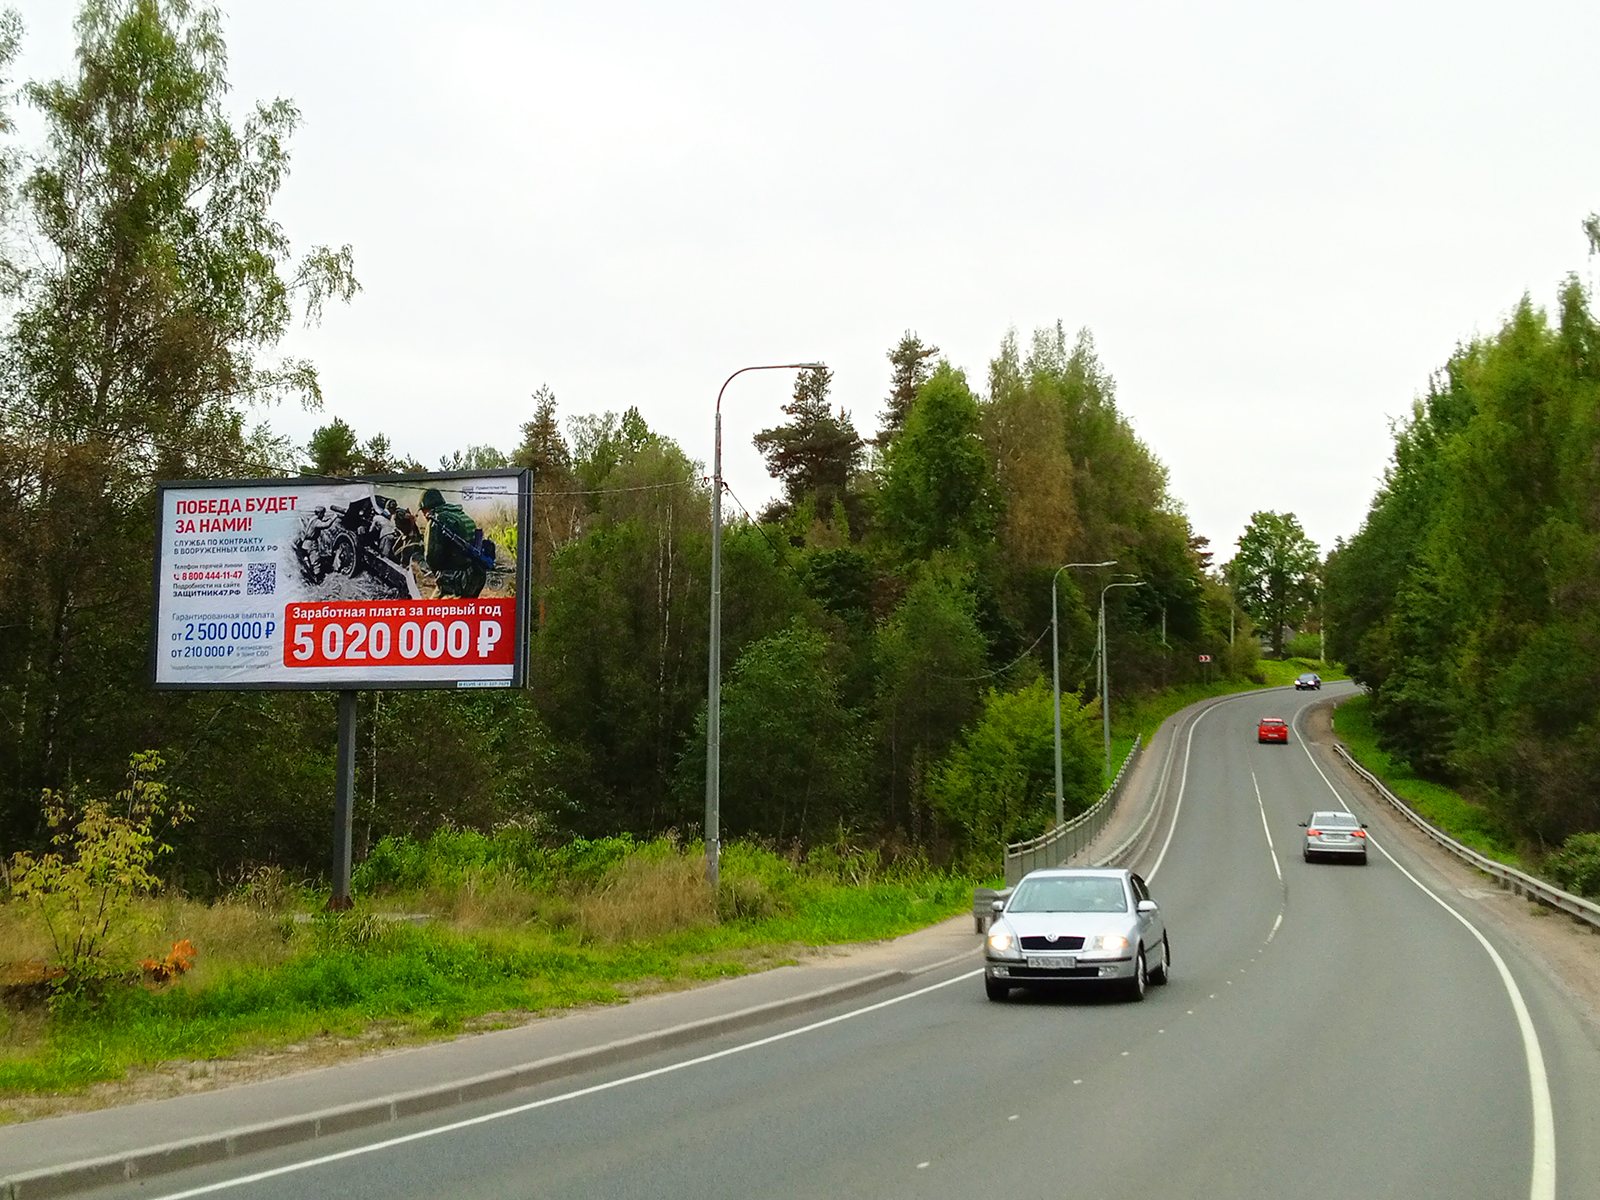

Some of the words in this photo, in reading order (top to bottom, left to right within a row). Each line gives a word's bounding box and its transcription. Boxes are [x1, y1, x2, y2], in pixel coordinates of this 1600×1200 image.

[176, 499, 242, 516] ПОБЕДА
[246, 496, 298, 514] БУДЕТ
[176, 520, 196, 534] ЗА
[200, 518, 252, 532] НАМИ!
[174, 539, 206, 547] СЛУЖБА
[180, 546, 238, 554] ВООРУЖЕННЫХ
[182, 572, 188, 580] 8
[188, 572, 204, 580] 800
[204, 570, 242, 580] 444-11-47
[173, 590, 240, 598] ЗАЩИТНИК47.РФ
[172, 612, 240, 621] Гарантированная
[292, 607, 366, 620] Заработная
[369, 608, 406, 618] плата
[409, 607, 424, 616] за
[426, 604, 476, 619] первый
[478, 605, 502, 616] год
[172, 633, 182, 641] от
[185, 623, 194, 640] 2
[198, 622, 228, 640] 500
[231, 622, 262, 640] 000
[292, 624, 314, 660] 5
[322, 622, 391, 660] 020
[398, 620, 470, 659] 000
[477, 620, 502, 658] ₽
[171, 650, 182, 658] от
[184, 646, 202, 658] 210
[204, 646, 225, 658] 000
